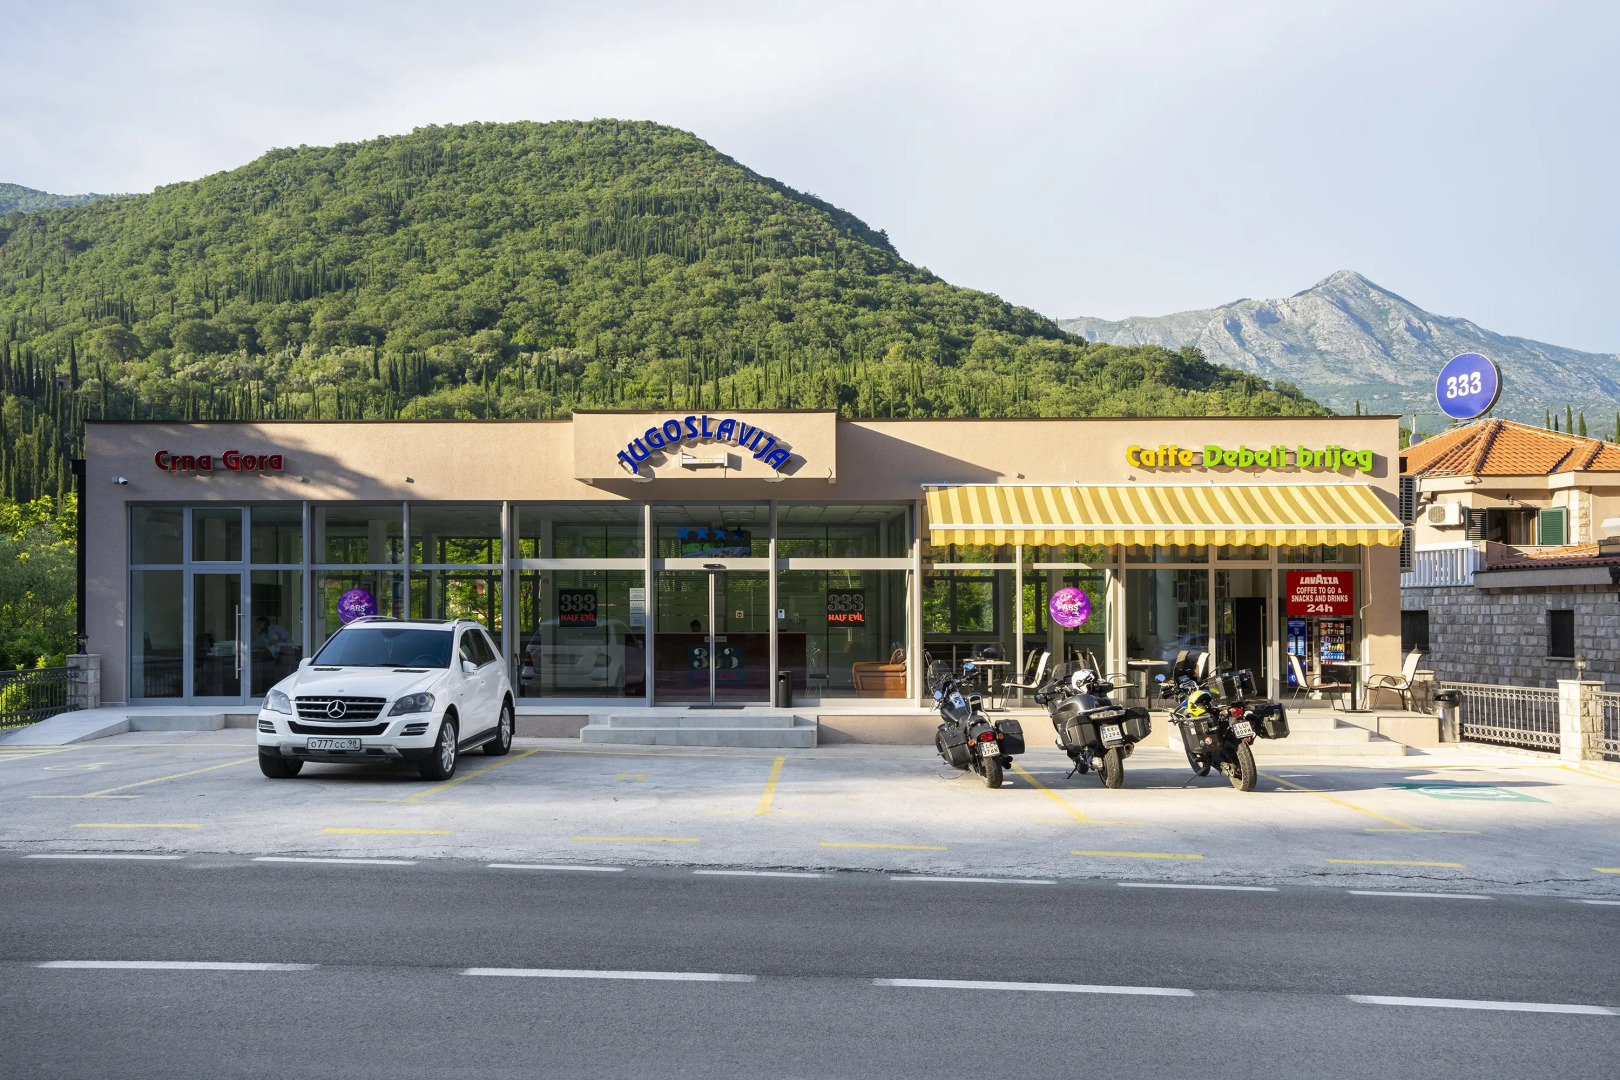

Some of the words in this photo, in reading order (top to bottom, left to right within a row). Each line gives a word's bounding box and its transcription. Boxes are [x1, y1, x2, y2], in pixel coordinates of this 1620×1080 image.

[1446, 371, 1482, 399] 333
[617, 415, 791, 474] JUGOSLAVIJA
[154, 450, 212, 471] Crna
[222, 450, 284, 471] Gora
[1126, 445, 1193, 467] Caffe
[1203, 445, 1286, 467] Debeli
[1298, 445, 1373, 472] brijeg
[1300, 574, 1339, 584] LAVAZZA
[560, 594, 596, 612] 333
[828, 594, 864, 611] 333
[1306, 604, 1333, 612] 24h
[829, 614, 847, 622] HALF
[848, 612, 865, 622] EVIL
